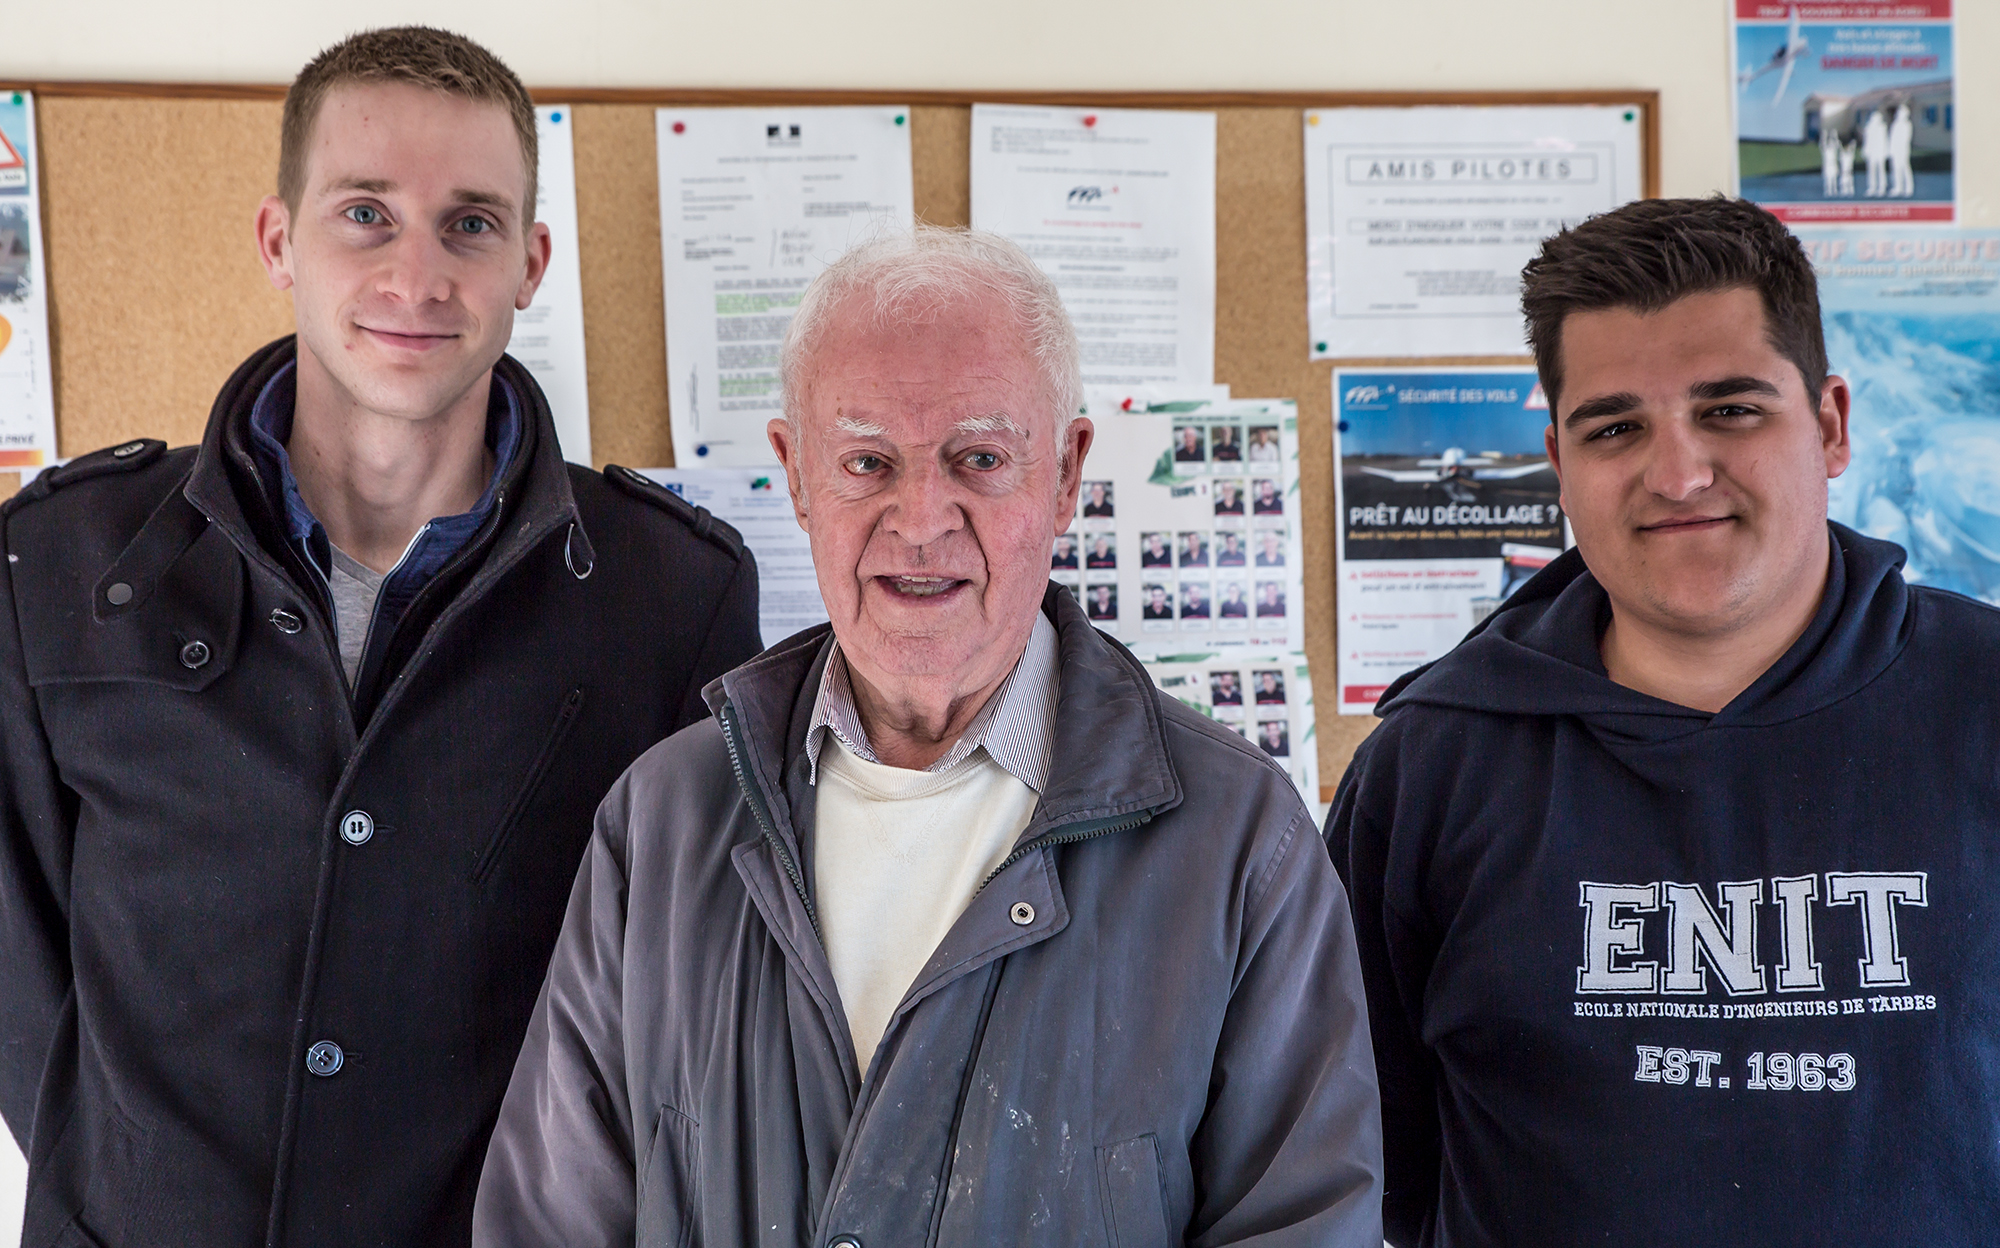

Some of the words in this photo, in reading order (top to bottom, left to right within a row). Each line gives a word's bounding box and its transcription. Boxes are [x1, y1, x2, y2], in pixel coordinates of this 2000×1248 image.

[1367, 160, 1436, 179] AMIS
[1451, 158, 1572, 179] PILOTES
[1459, 388, 1485, 403] DES
[1350, 502, 1400, 526] PRÊT
[1402, 506, 1430, 525] AU
[1433, 501, 1544, 525] DÉCOLLAGE
[1546, 504, 1560, 523] ?
[1576, 871, 1929, 997] ENIT
[1574, 1002, 1624, 1018] ECOLE
[1626, 1002, 1720, 1019] NATIONALE
[1723, 1000, 1839, 1019] D'INGENIEURS
[1843, 998, 1865, 1014] DE
[1868, 995, 1937, 1012] TARBES
[1635, 1045, 1730, 1089] EST.
[1747, 1051, 1857, 1092] 1963
